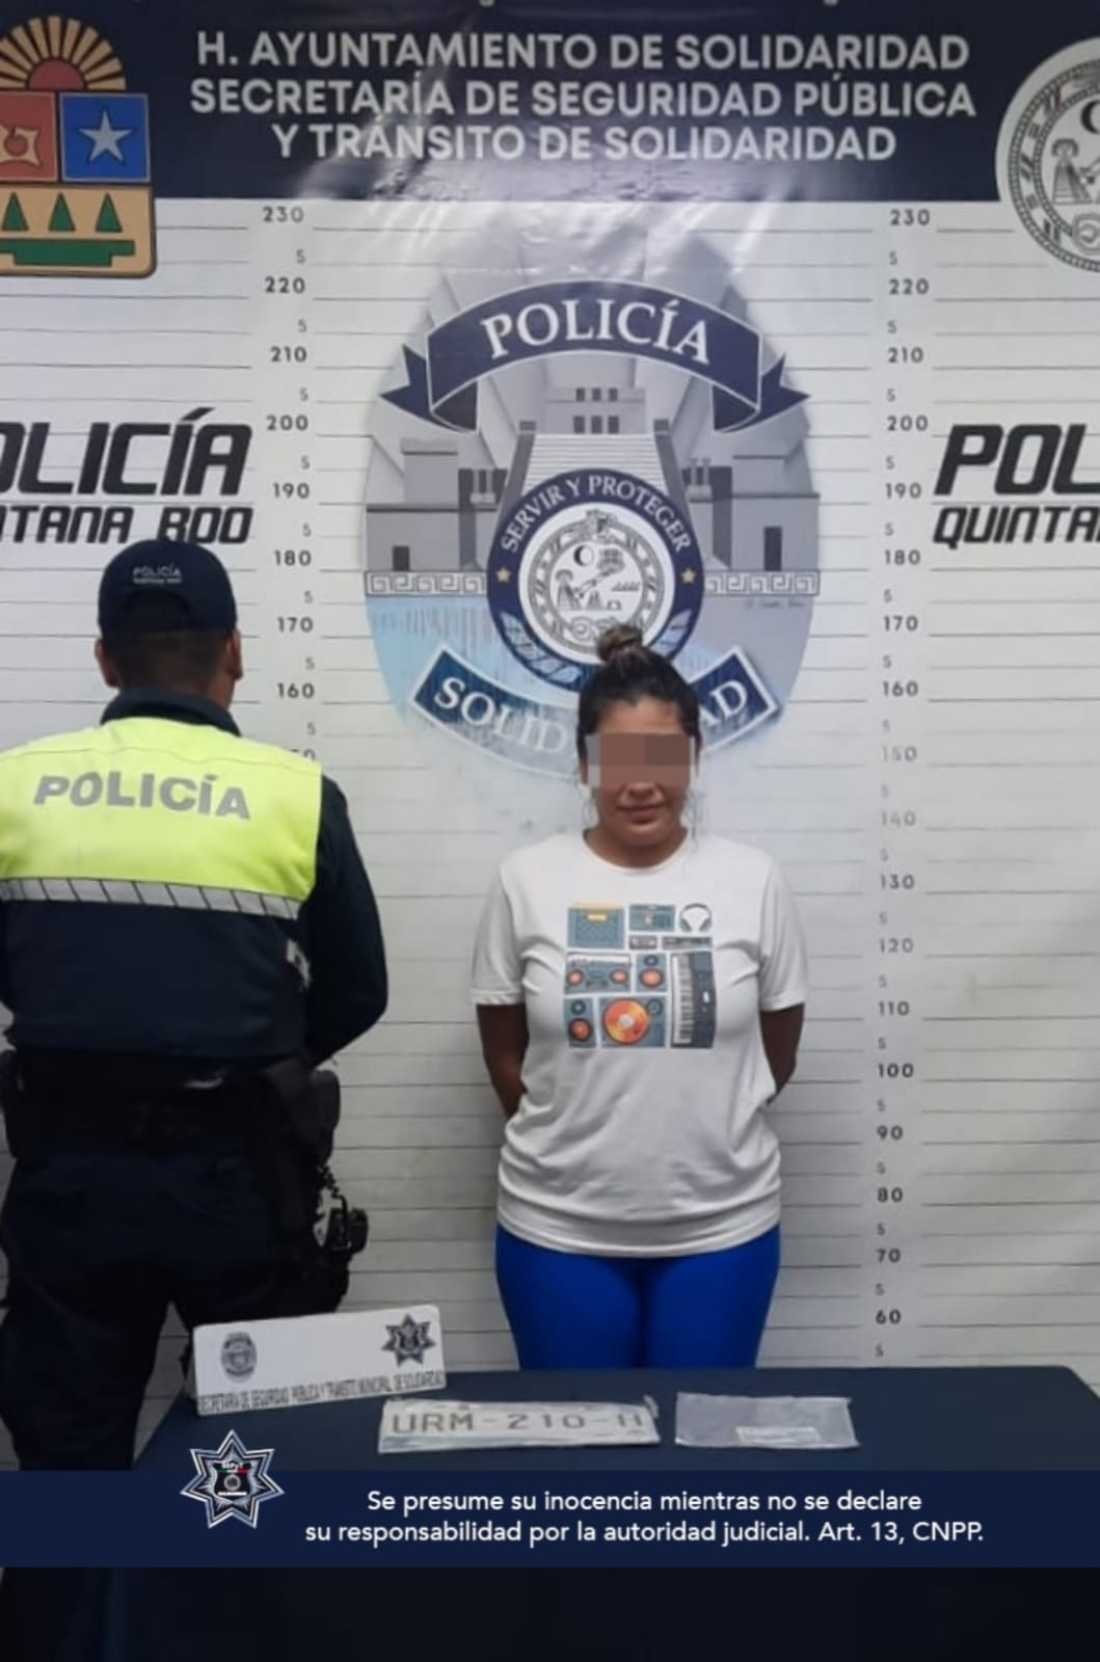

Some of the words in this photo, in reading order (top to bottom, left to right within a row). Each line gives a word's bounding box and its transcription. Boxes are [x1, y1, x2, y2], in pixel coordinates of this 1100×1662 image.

[198, 31, 238, 65] H.
[251, 32, 597, 69] AYUNTAMIENTO
[610, 34, 665, 69] DE
[677, 34, 969, 69] SOLIDARIDAD
[191, 72, 455, 116] SECRETARÍA
[466, 80, 520, 116] DE
[533, 82, 781, 117] SEGURIDAD
[794, 73, 976, 117] PÚBLICA
[272, 124, 299, 158] Y
[308, 118, 526, 161] TRÁNSITO
[540, 127, 592, 160] DE
[604, 127, 894, 162] SOLIDARIDAD
[262, 205, 304, 223] 230
[890, 208, 931, 227] 230
[295, 248, 307, 265] 5
[265, 275, 306, 294] 220
[889, 277, 930, 296] 220
[297, 318, 308, 333] 5
[480, 298, 710, 365] POLICÍA
[270, 345, 308, 363] 210
[888, 346, 924, 364] 210
[299, 387, 309, 402] 5
[266, 414, 309, 432] 200
[887, 414, 929, 432] 200
[300, 455, 311, 470] 5
[273, 482, 310, 499] 190
[885, 481, 923, 499] 190
[502, 484, 565, 553] SERVIR
[566, 477, 581, 498] Y
[588, 475, 691, 552] PROTEGER
[302, 522, 312, 538] 5
[274, 549, 312, 567] 180
[885, 549, 921, 566] 180
[303, 590, 314, 604] 5
[277, 616, 314, 633] 170
[883, 615, 919, 632] 170
[305, 656, 316, 670] 5
[277, 682, 315, 699] 160
[883, 680, 919, 697] 160
[306, 721, 317, 736] 5
[34, 771, 251, 819] POLICÍA
[881, 874, 915, 890] 130
[879, 937, 914, 953] 120
[878, 1000, 910, 1017] 110
[878, 1063, 914, 1078] 100
[876, 1125, 903, 1141] 90
[877, 1187, 903, 1203] 80
[877, 1248, 901, 1263] 70
[875, 1309, 902, 1325] 60
